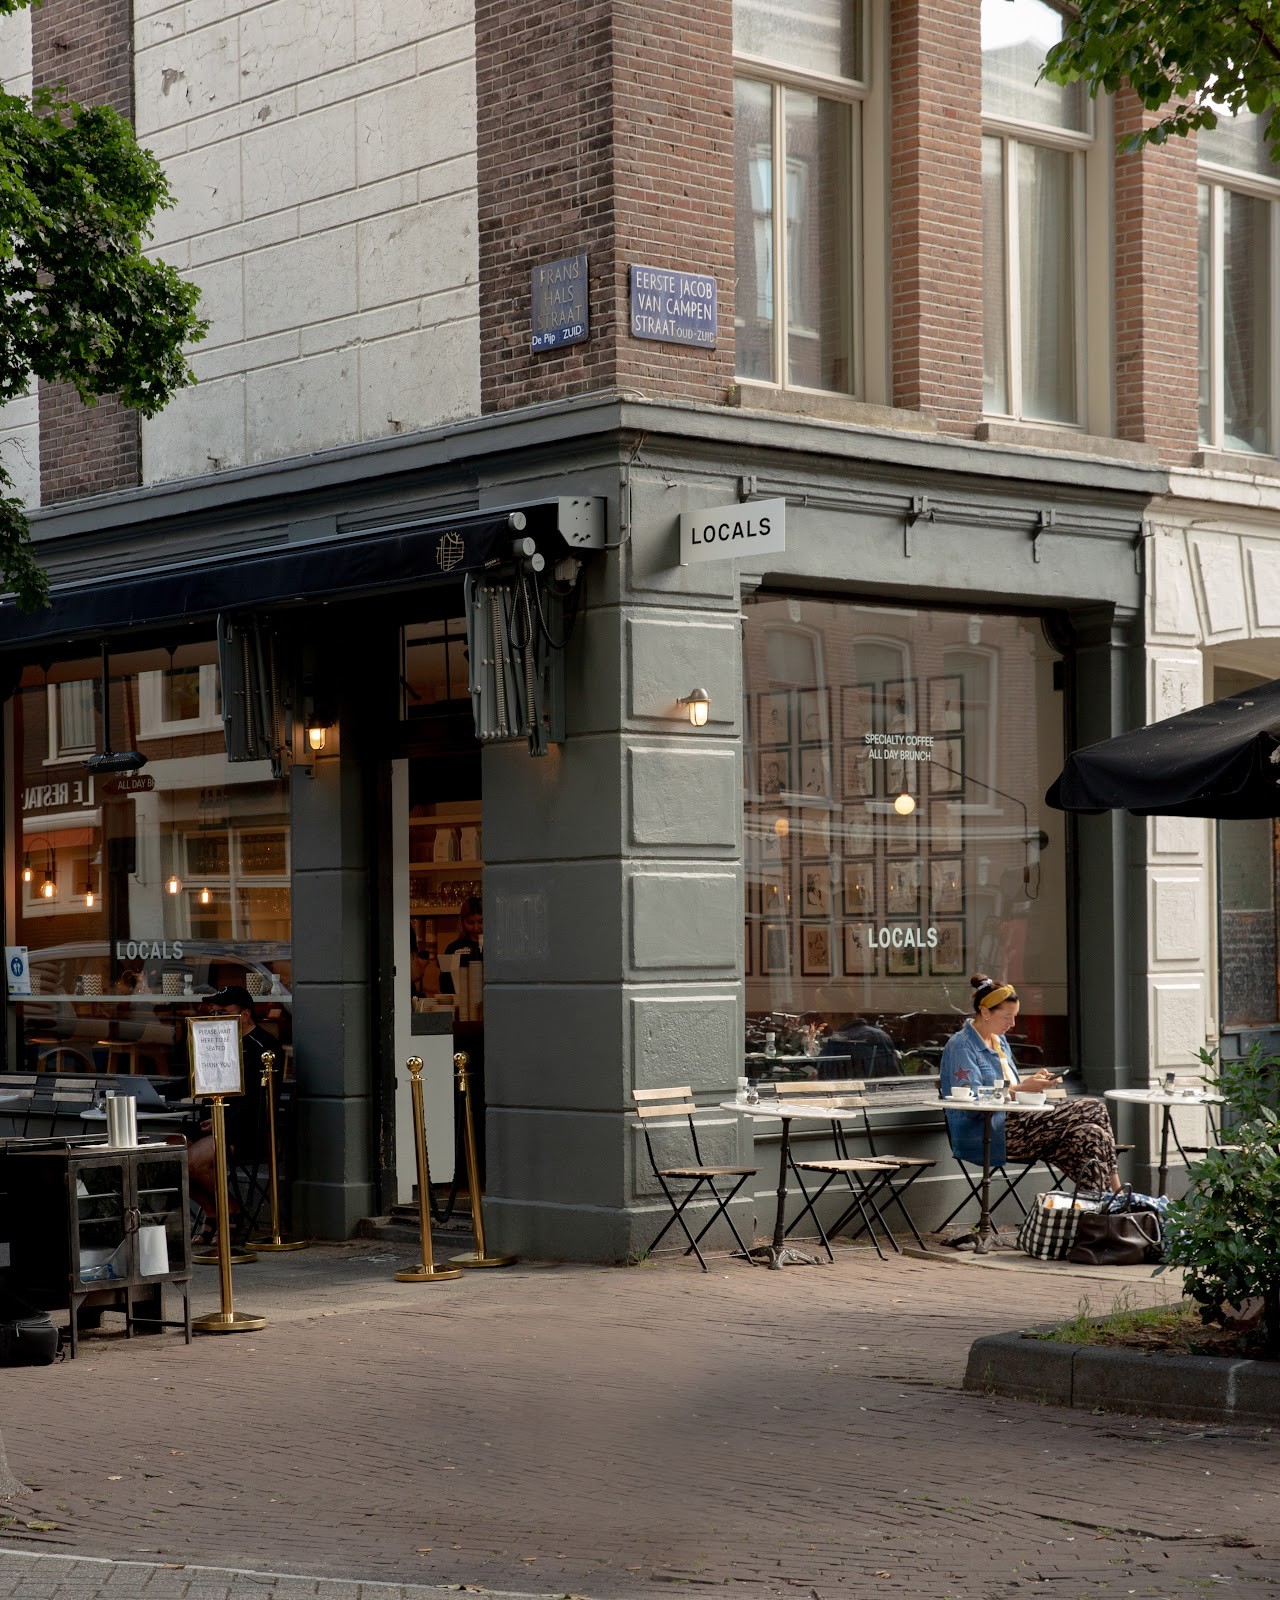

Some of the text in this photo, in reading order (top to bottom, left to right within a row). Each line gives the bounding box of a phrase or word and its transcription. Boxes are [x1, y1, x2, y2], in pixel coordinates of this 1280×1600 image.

[540, 262, 579, 285] FRANS
[544, 285, 574, 307] HALS
[636, 271, 713, 299] EERSTE JACOB
[637, 292, 712, 321] VAN CAMPEN
[537, 305, 582, 331] STRAAT
[635, 315, 715, 343] STRAAT OUD-ZUID
[532, 325, 582, 346] De Pijp ZUID
[692, 517, 771, 545] LOCALS
[865, 734, 934, 747] SPECIALTY COFFEE
[868, 749, 931, 761] ALL DAY BRUNCH
[117, 780, 131, 790] ALL
[132, 779, 146, 789] DAY
[868, 927, 938, 948] LOCALS
[116, 941, 184, 960] LOCALS
